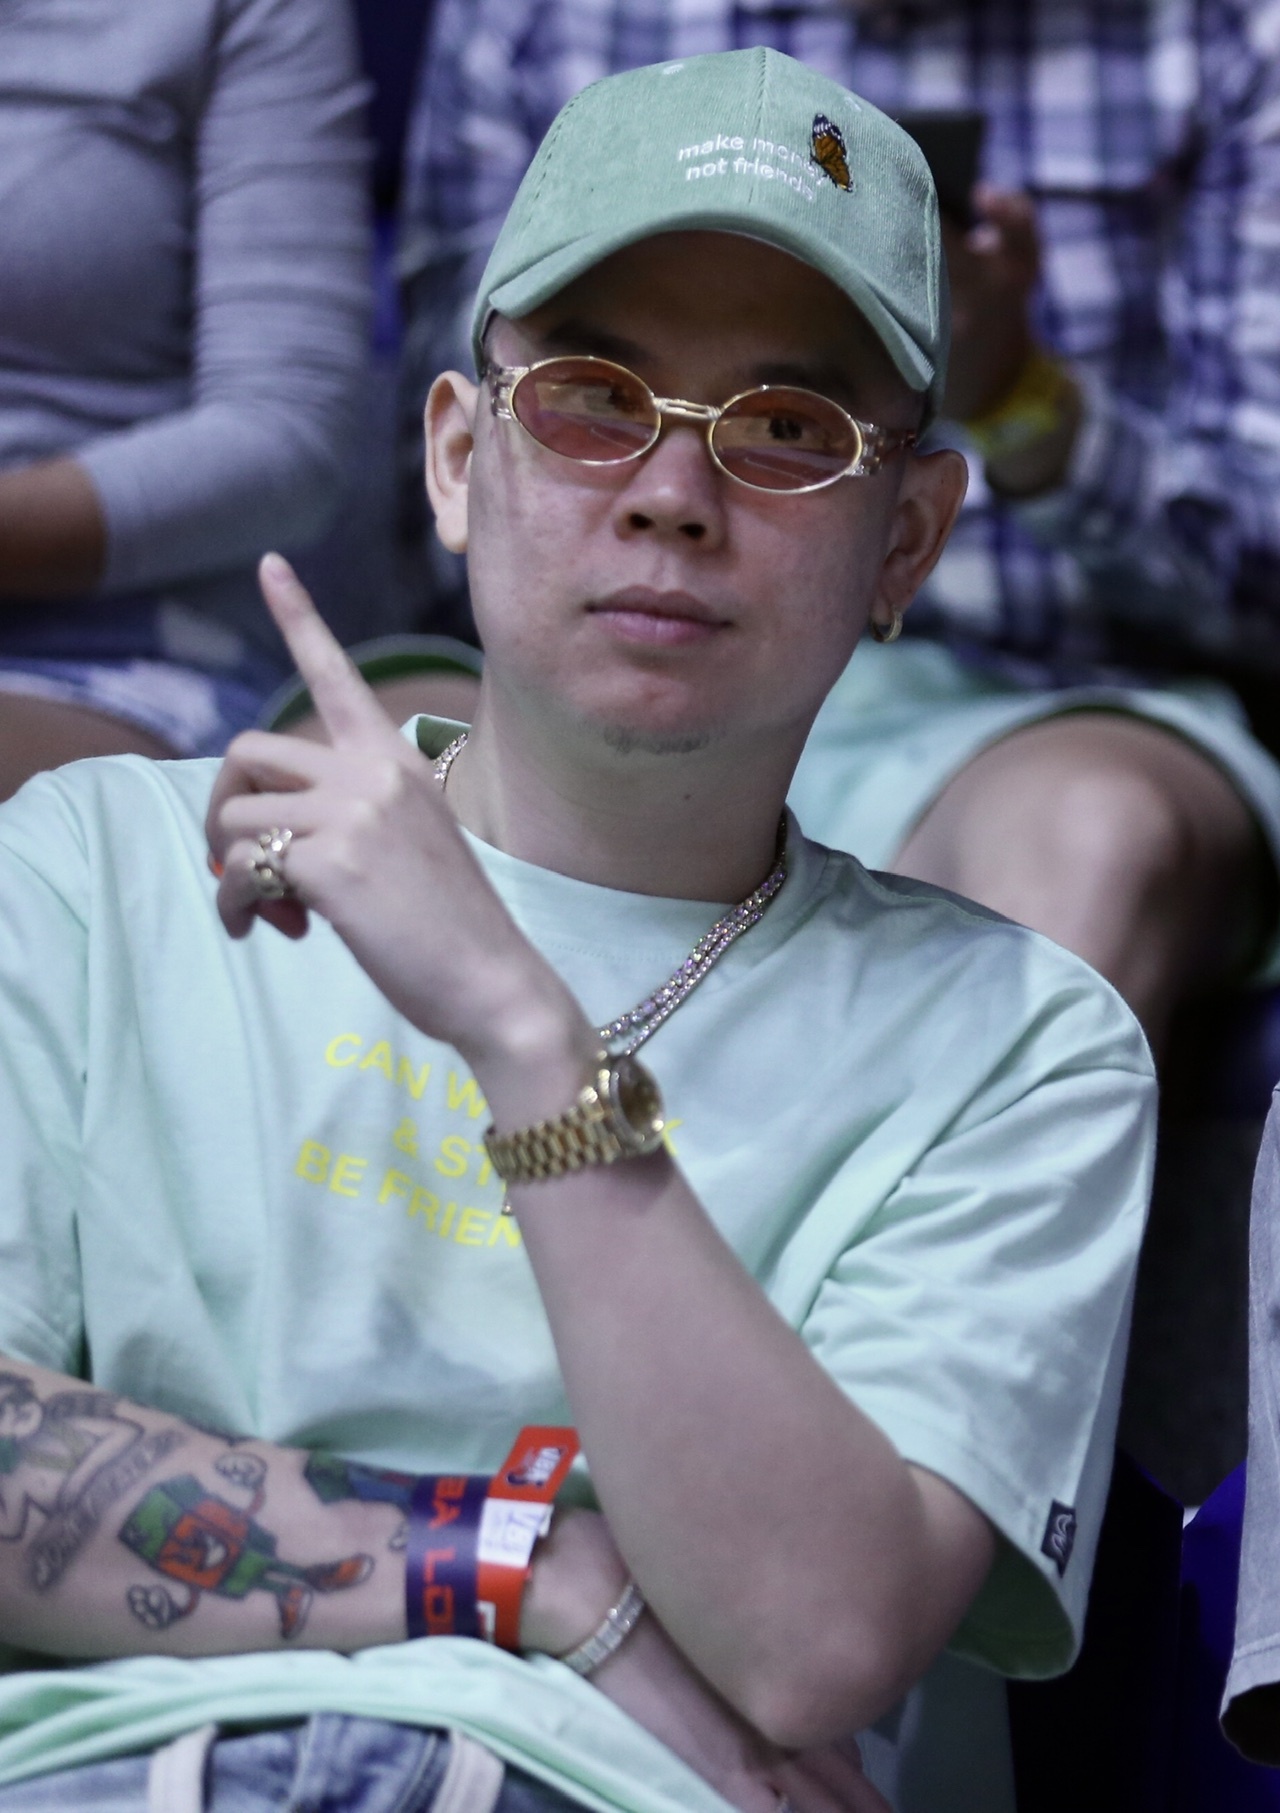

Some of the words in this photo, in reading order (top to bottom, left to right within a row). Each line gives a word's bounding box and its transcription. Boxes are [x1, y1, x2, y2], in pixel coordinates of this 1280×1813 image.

[677, 134, 745, 161] make
[753, 137, 830, 185] money
[686, 158, 729, 181] not
[733, 157, 816, 201] friends
[325, 1033, 431, 1099] CAN
[392, 1117, 420, 1160] &
[434, 1135, 507, 1193] ST
[296, 1138, 367, 1197] BE
[378, 1168, 522, 1247] FRIEN
